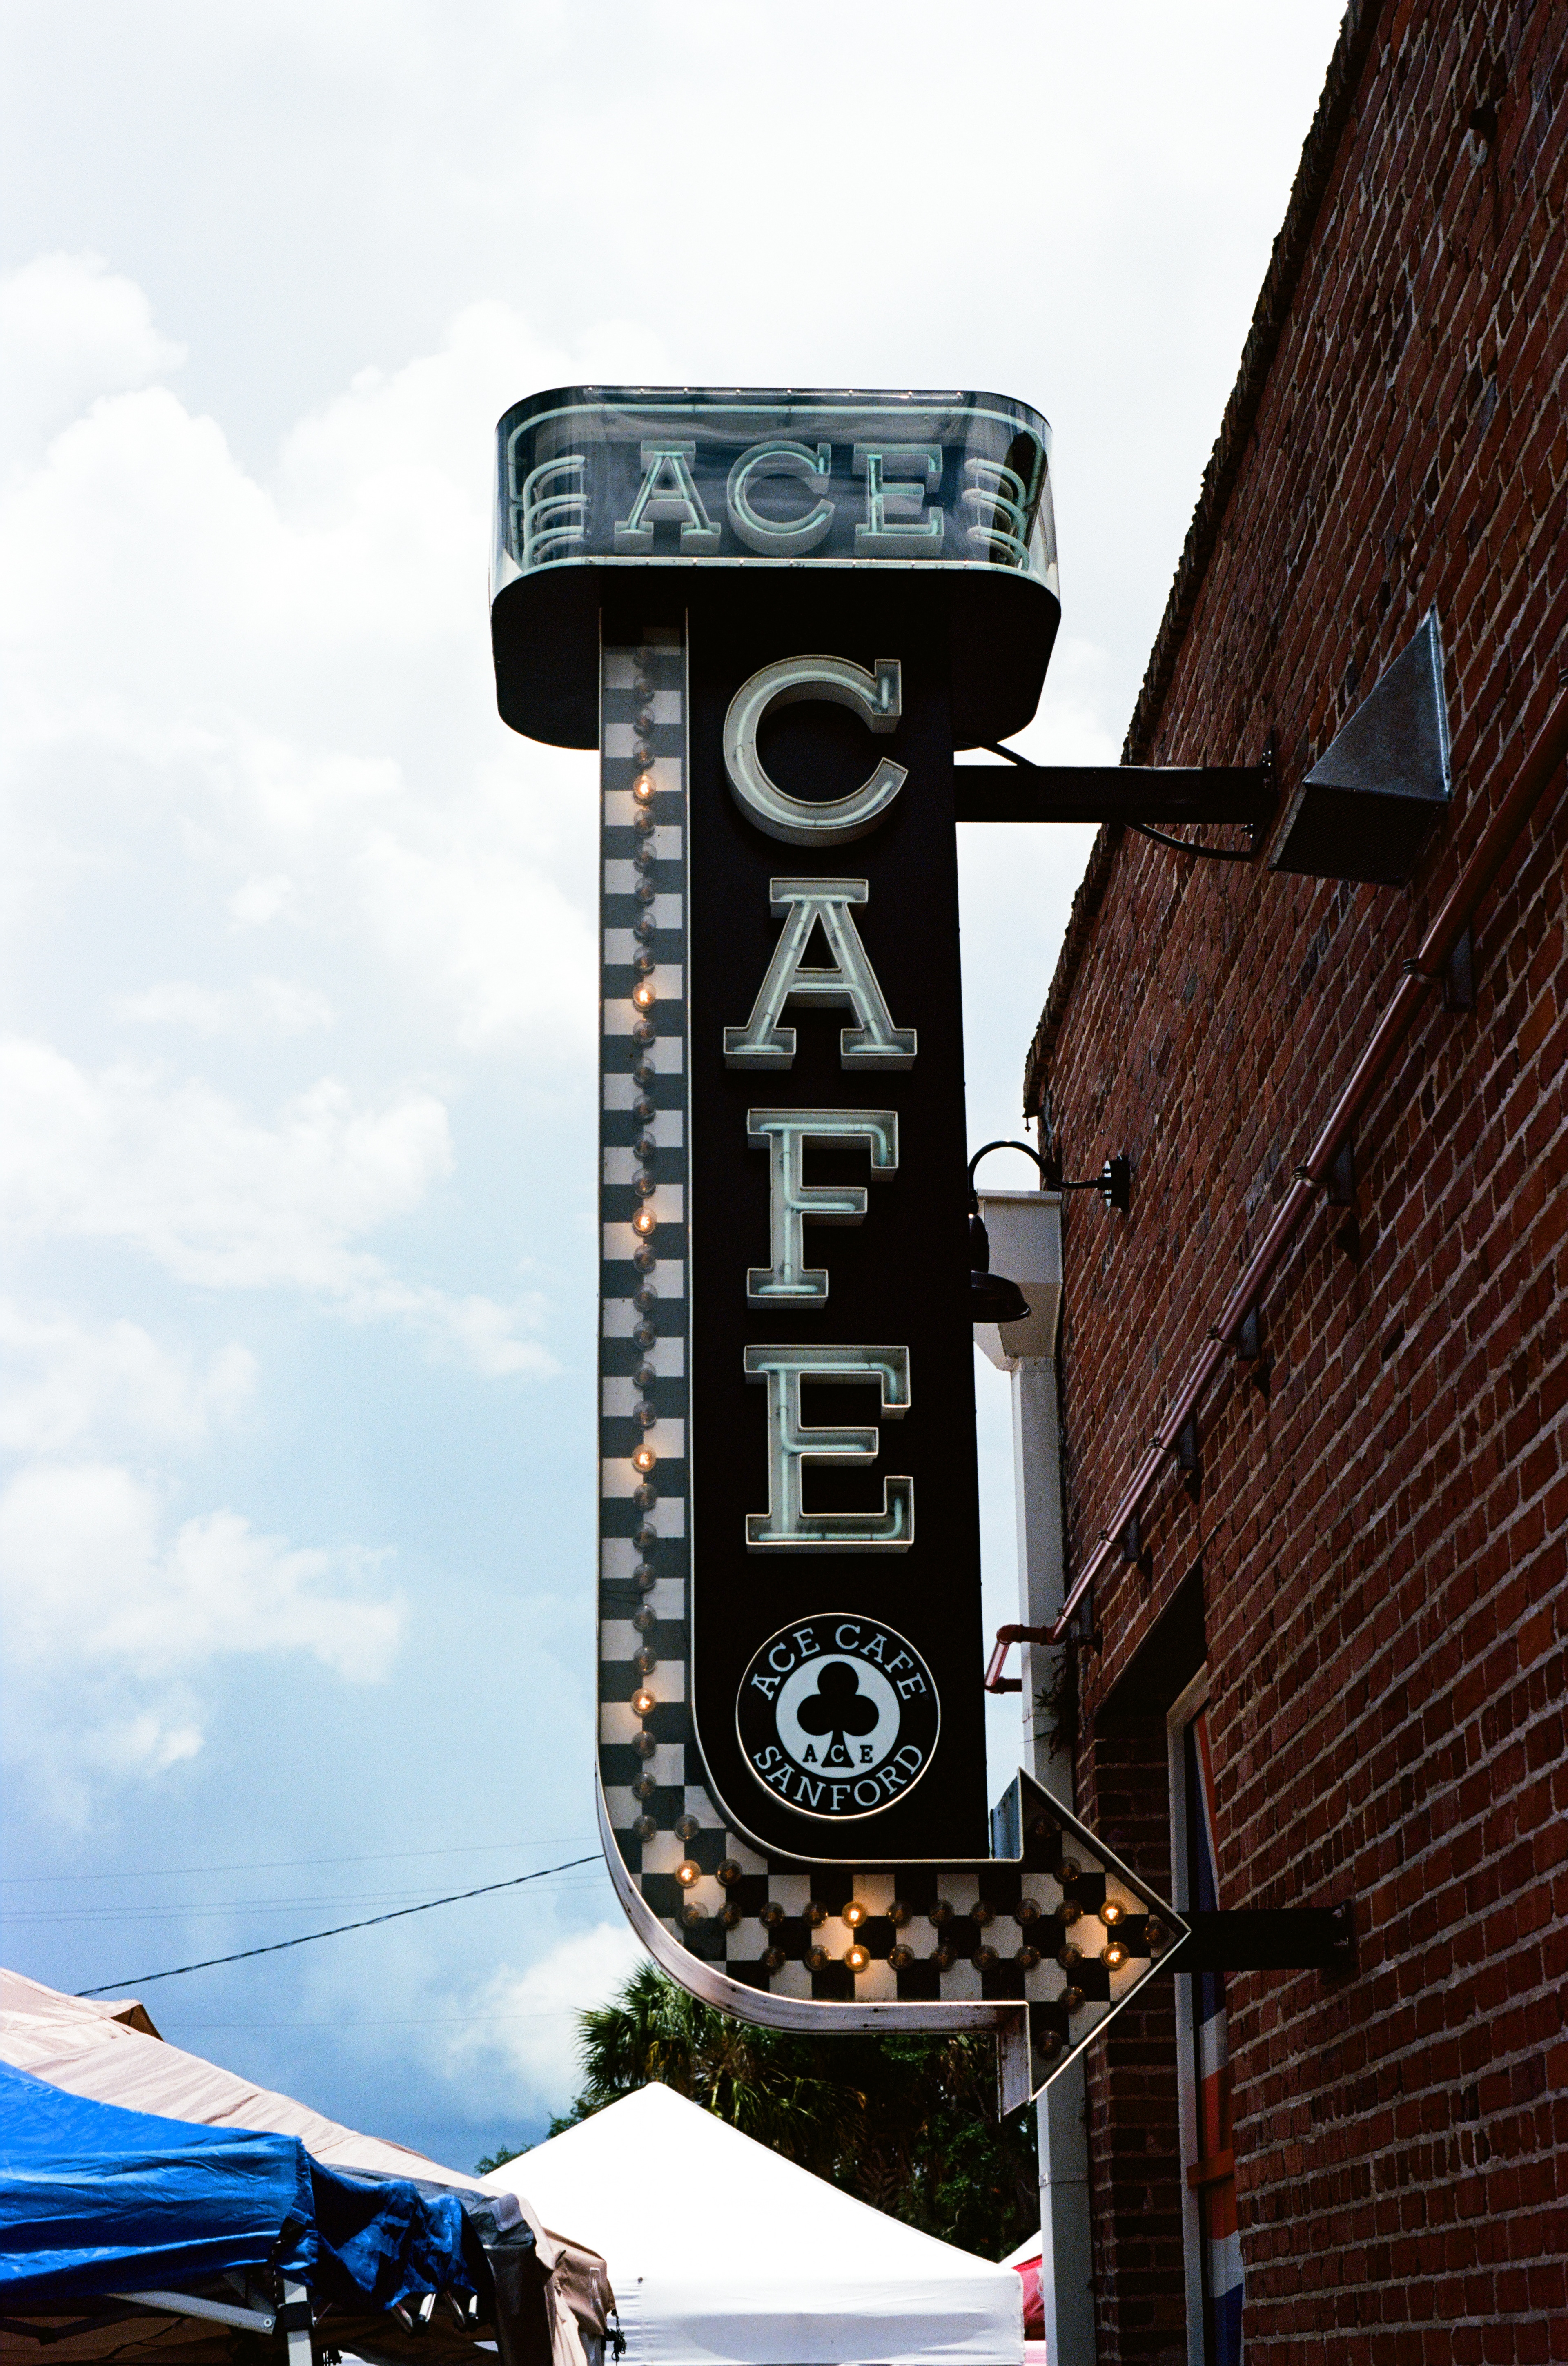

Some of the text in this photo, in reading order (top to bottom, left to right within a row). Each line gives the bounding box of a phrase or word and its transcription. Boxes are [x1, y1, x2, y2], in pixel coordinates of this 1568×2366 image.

[615, 440, 944, 556] ACE
[723, 654, 917, 1553] CAFE
[751, 1624, 927, 1700] ACE CAFE
[753, 1745, 922, 1810] SANFORD
[802, 1744, 873, 1764] ACE
